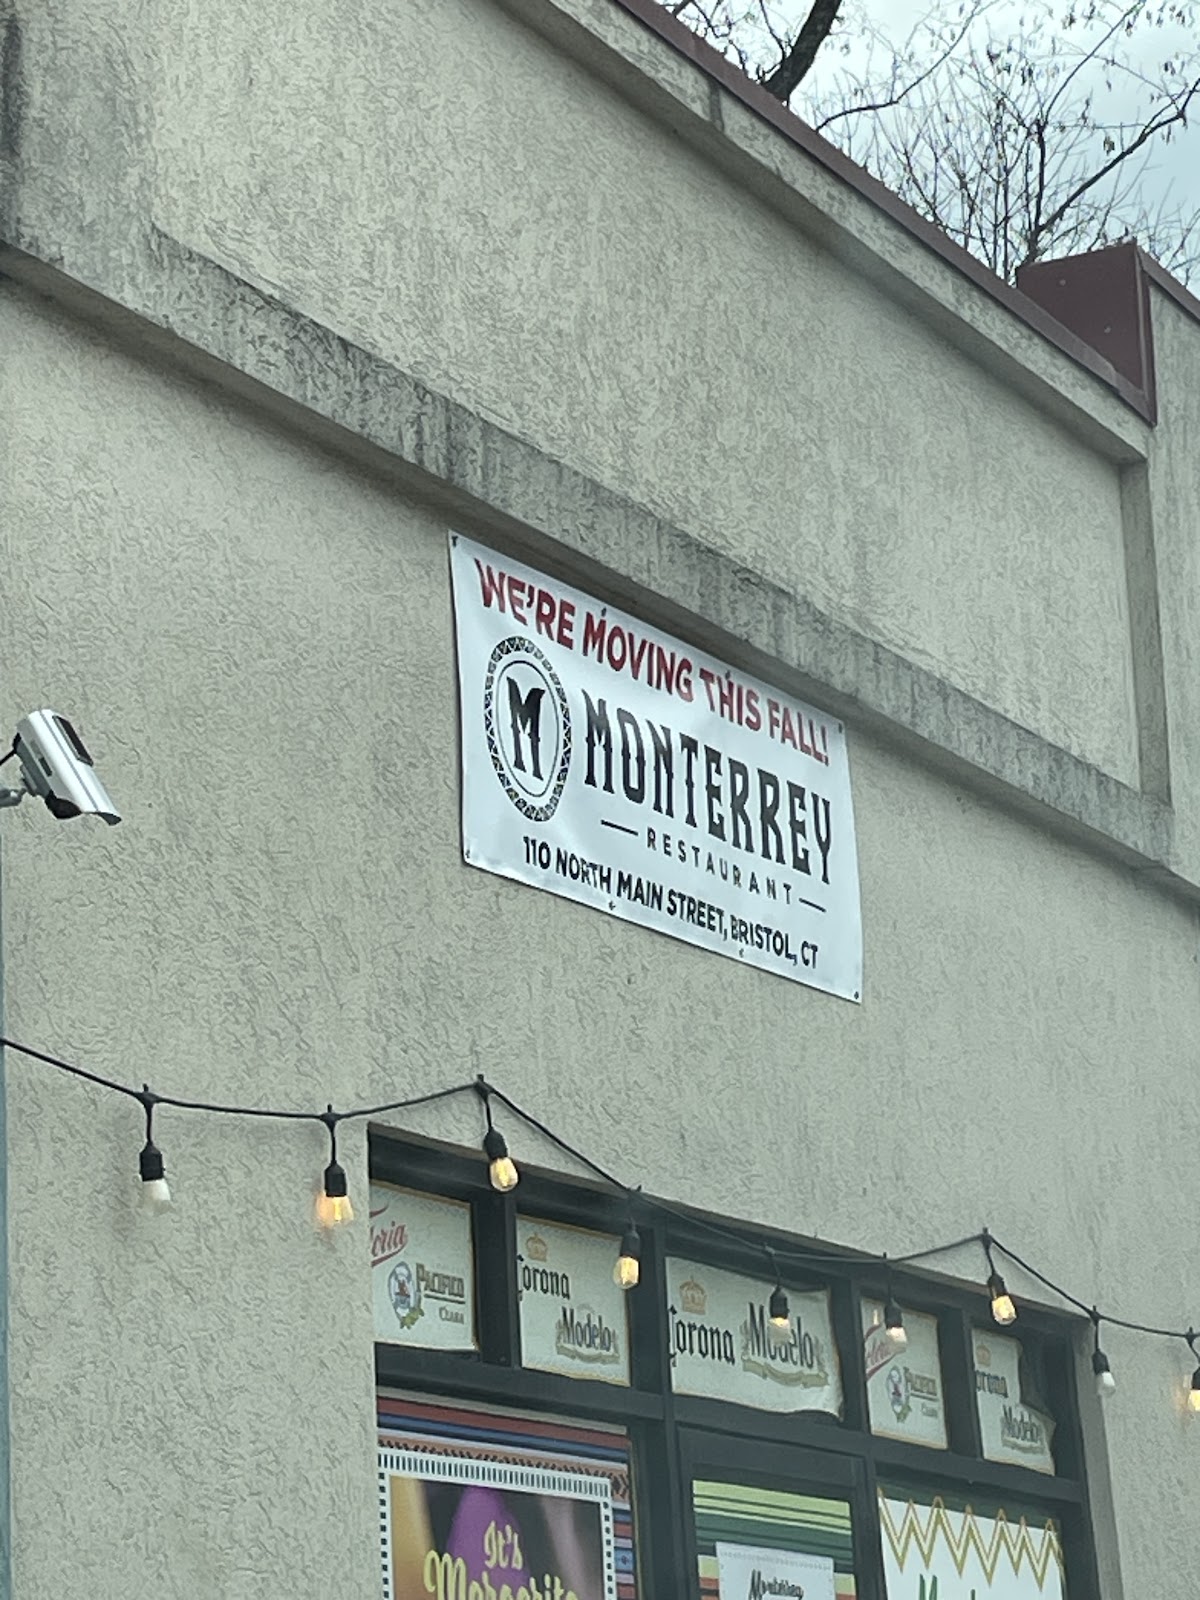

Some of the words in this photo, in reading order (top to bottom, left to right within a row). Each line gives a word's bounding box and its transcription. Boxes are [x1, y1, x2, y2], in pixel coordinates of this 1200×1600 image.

[474, 557, 575, 650] WE'RE
[583, 611, 694, 702] MOVING
[699, 668, 761, 732] THIS
[768, 699, 829, 766] FALL!
[506, 676, 546, 781] M
[581, 688, 832, 885] MONTERREY
[523, 836, 551, 870] 110
[556, 847, 611, 894] NORTH
[617, 870, 663, 911] MAIN
[667, 888, 728, 941] STREET,
[731, 914, 798, 966] BRISTOL,
[801, 943, 818, 969] CT
[646, 826, 793, 907] RESTAURANT
